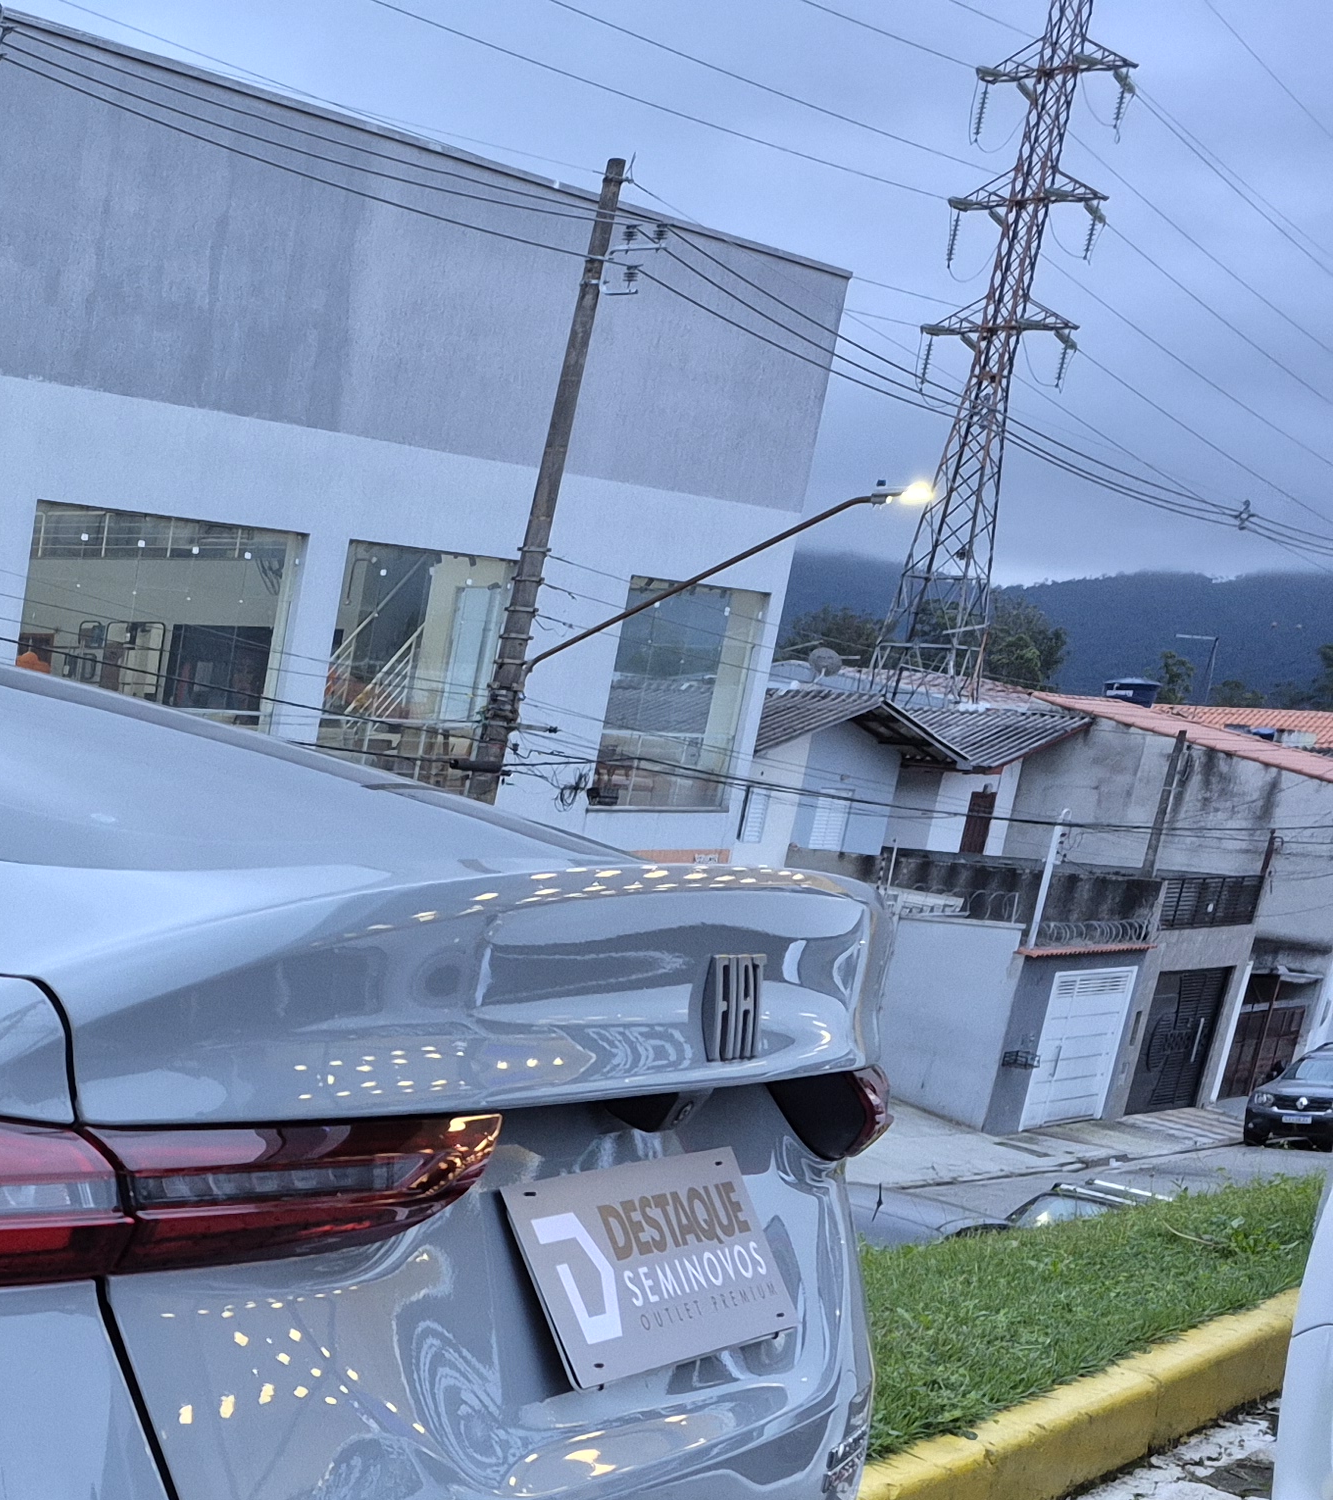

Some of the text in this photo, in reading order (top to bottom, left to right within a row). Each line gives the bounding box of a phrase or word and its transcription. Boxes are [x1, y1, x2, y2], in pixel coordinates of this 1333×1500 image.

[596, 1181, 752, 1262] DESTAQUE
[623, 1241, 767, 1307] SEMINOVOS
[639, 1282, 779, 1331] OUTLET PREMIUM
